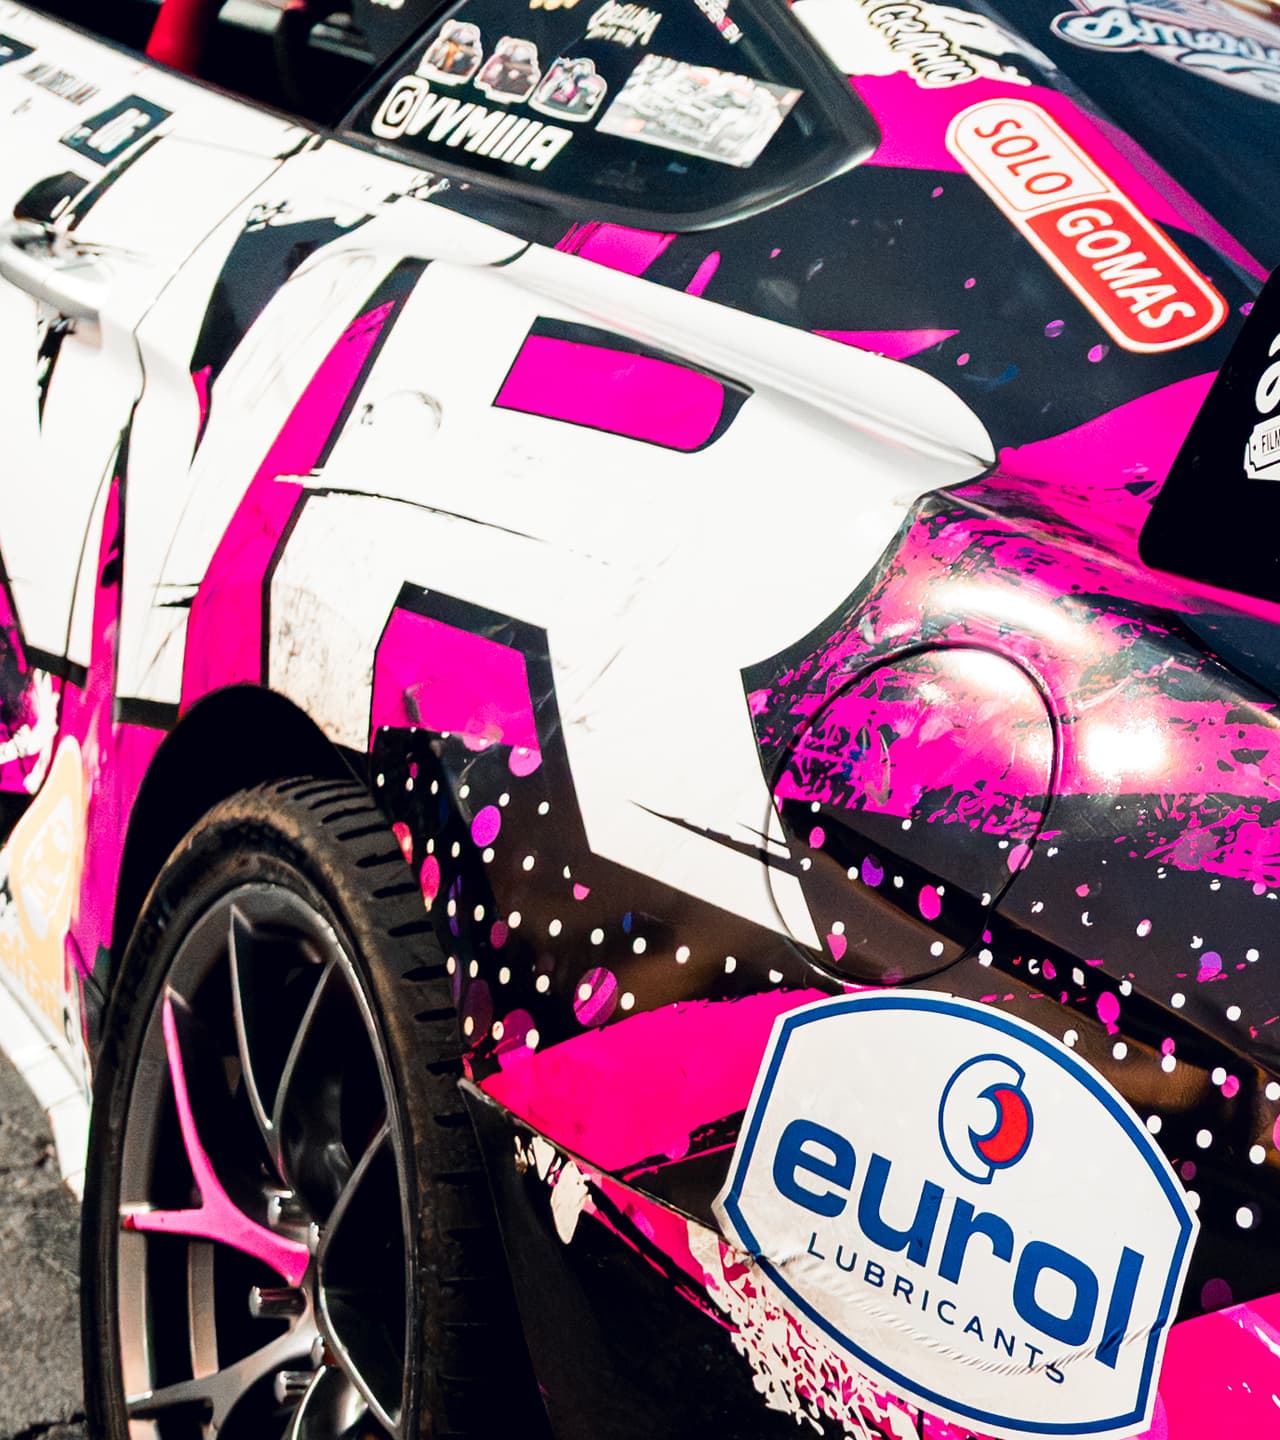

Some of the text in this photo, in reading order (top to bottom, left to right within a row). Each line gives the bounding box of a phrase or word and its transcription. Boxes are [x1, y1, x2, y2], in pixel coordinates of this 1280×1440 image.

[973, 118, 1074, 196] SOLO
[1056, 208, 1197, 329] GOMAS
[772, 1118, 1145, 1370] eurol
[806, 1231, 1067, 1385] LUBRICANTS
